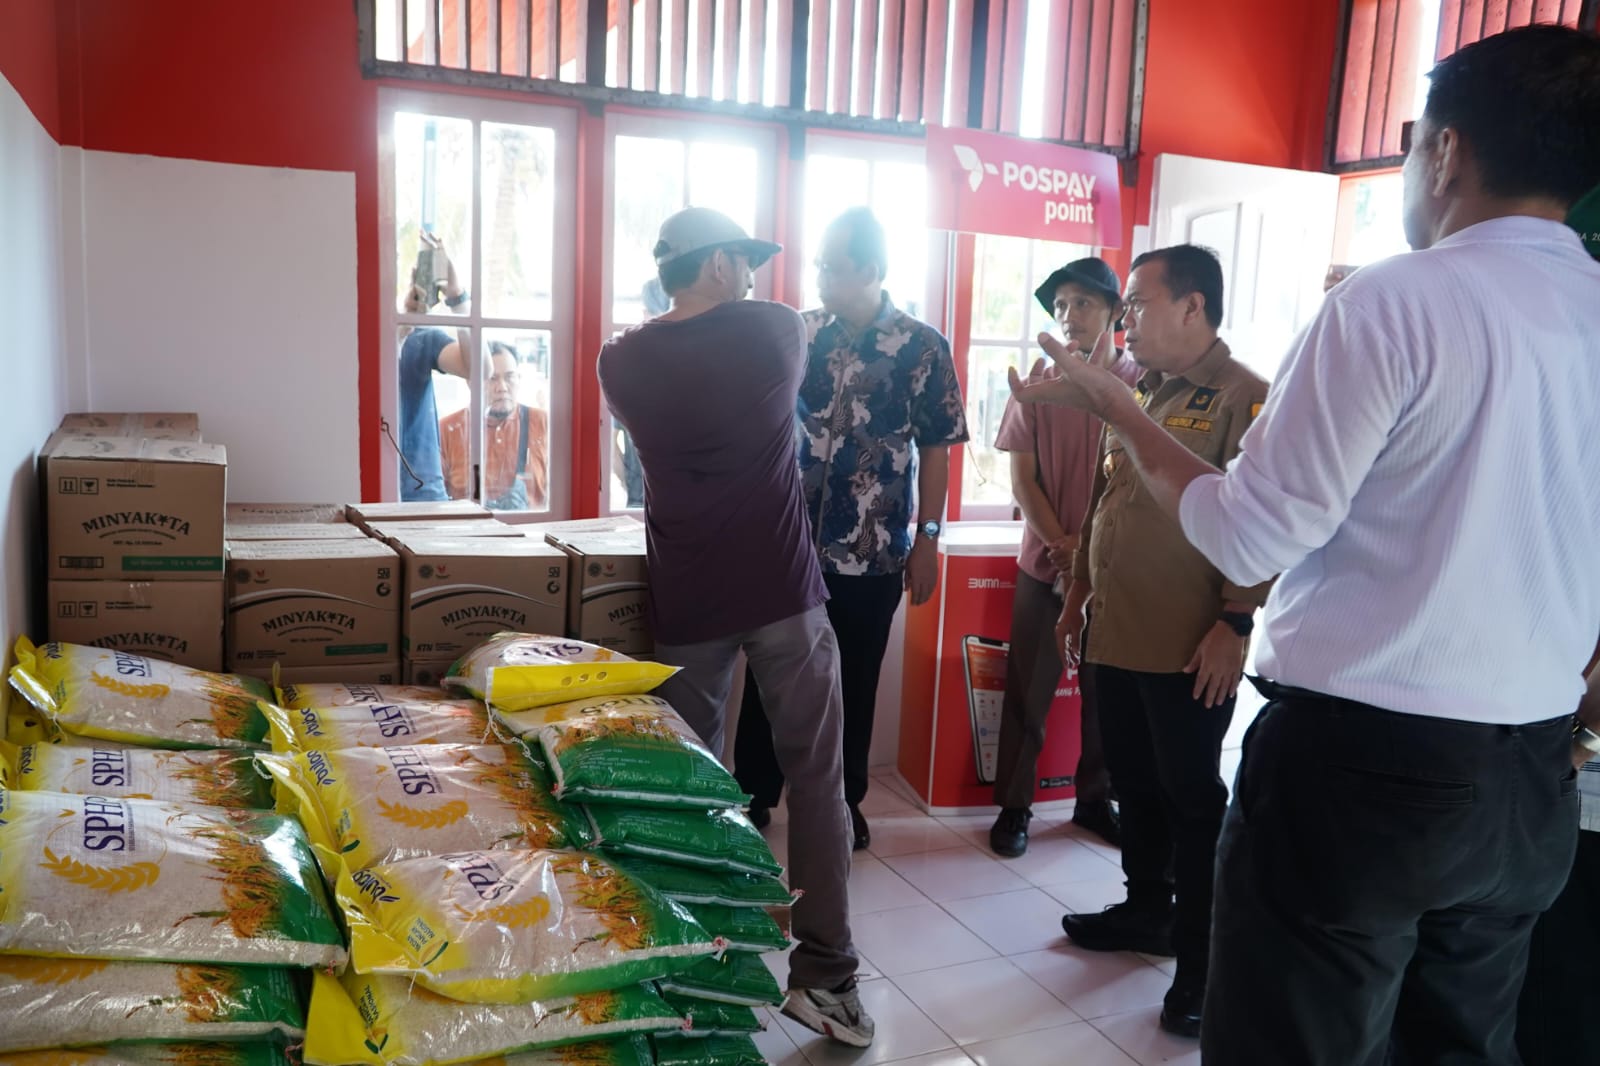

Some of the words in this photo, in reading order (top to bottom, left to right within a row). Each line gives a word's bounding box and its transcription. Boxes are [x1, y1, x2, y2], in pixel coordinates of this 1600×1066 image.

[1003, 161, 1096, 199] POSPAY
[1045, 197, 1094, 225] point
[92, 748, 125, 787] SPH
